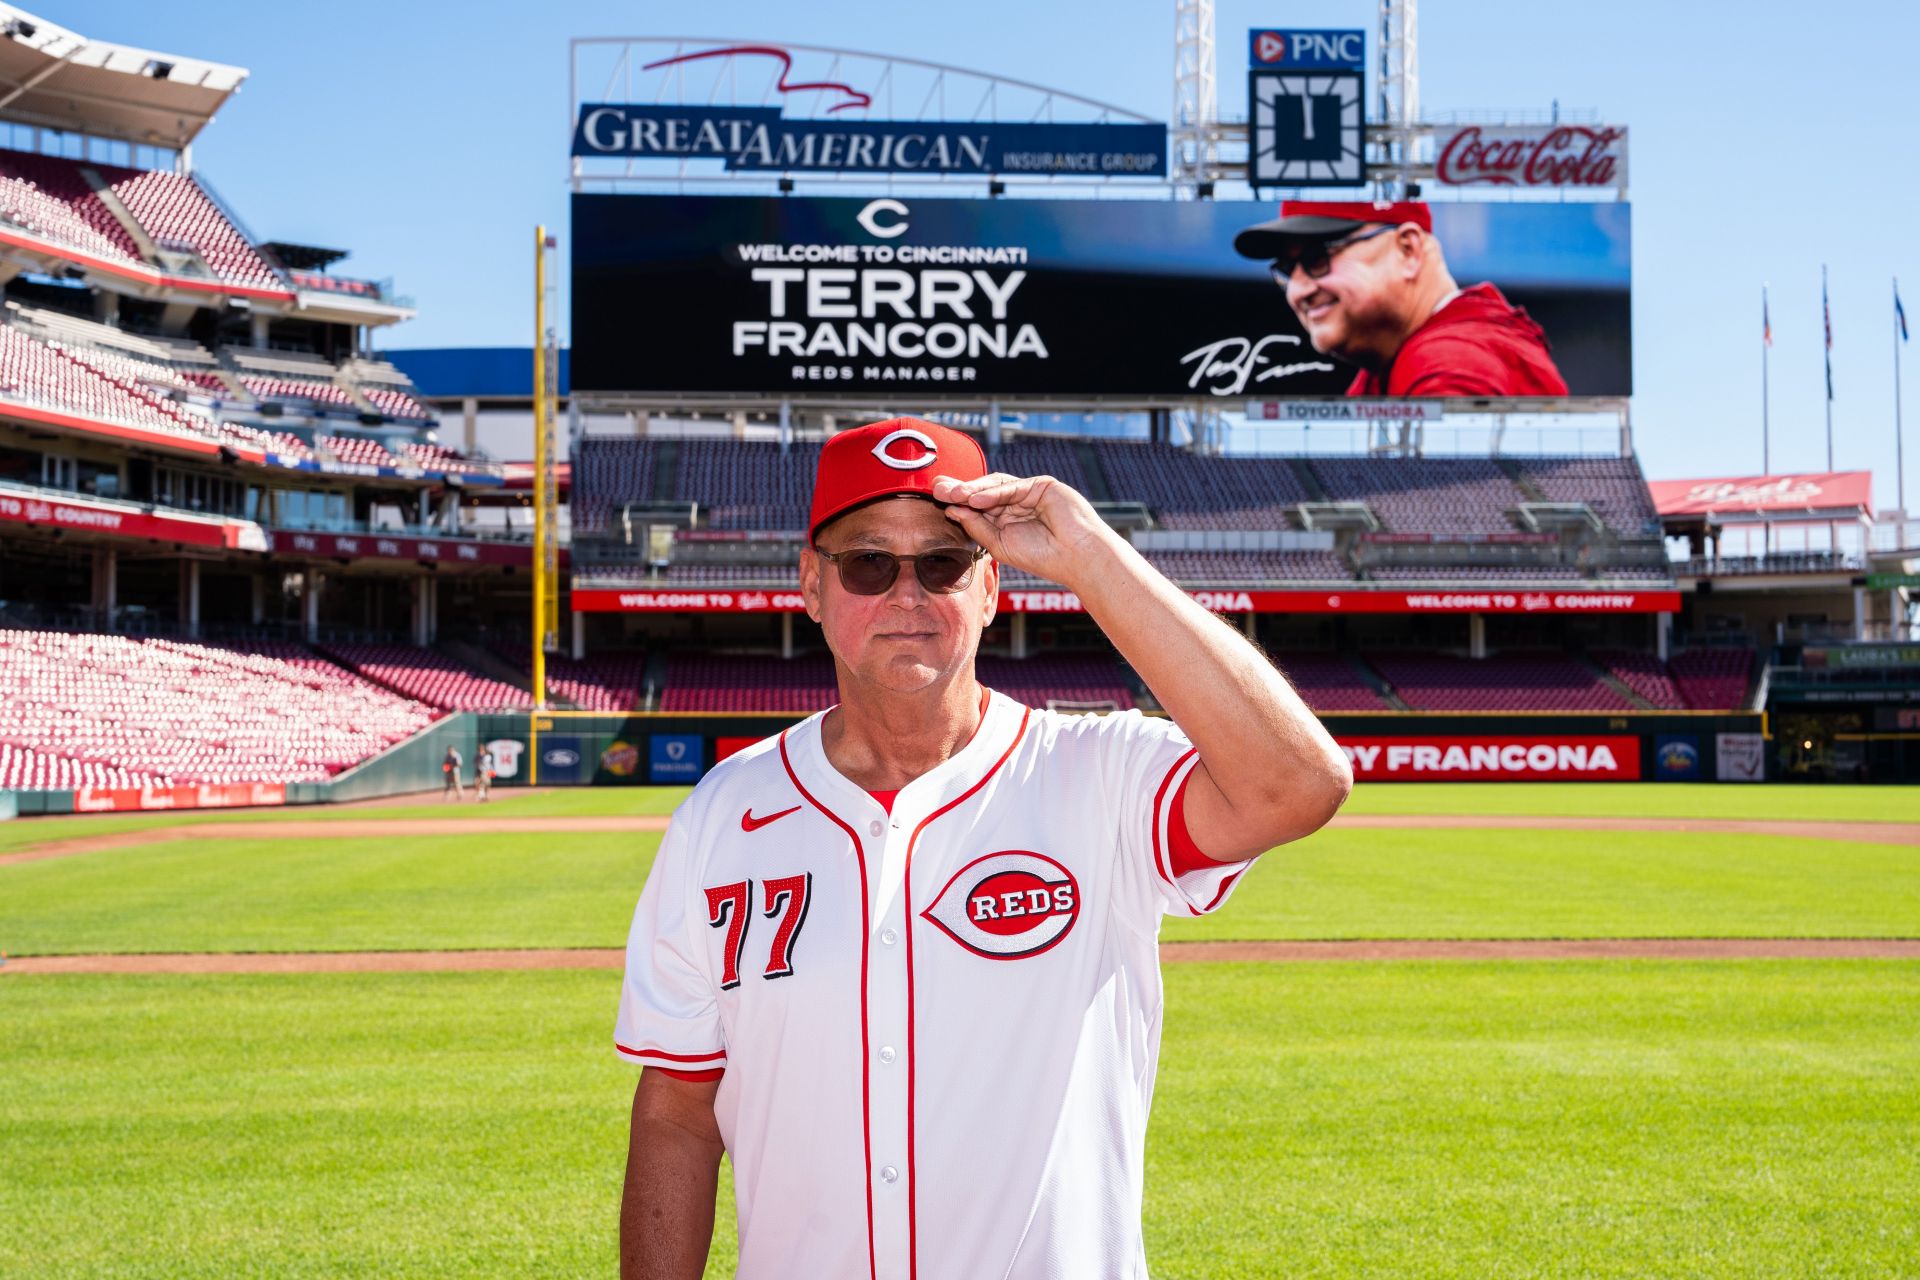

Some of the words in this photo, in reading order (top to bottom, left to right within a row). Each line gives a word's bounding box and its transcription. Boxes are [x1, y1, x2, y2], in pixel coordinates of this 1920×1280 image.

[1291, 34, 1362, 62] PNC
[583, 106, 750, 152] GREAT
[738, 126, 987, 168] AMERICAN
[1003, 153, 1097, 170] INSURANCE
[1101, 153, 1158, 170] GROUP
[738, 243, 859, 263] WELCOME
[860, 245, 894, 263] TO
[896, 246, 1028, 265] CINCINNATI
[751, 268, 1027, 319] TERRY
[733, 321, 1049, 359] FRANCONA
[792, 366, 854, 380] REDS
[863, 366, 977, 381] MANAGER
[1286, 406, 1351, 419] TOYOTA
[1354, 406, 1425, 419] TUNDRA
[53, 506, 123, 529] COUNTRY
[618, 593, 706, 608] WELCOME
[708, 593, 733, 608] TO
[1009, 592, 1084, 611] TERR
[1406, 595, 1491, 608] WELCOME
[1493, 595, 1516, 608] TO
[1554, 595, 1636, 608] COUNTRY
[1387, 744, 1618, 771] FRANCONA
[972, 884, 1075, 922] REDS
[703, 870, 812, 991] 77
